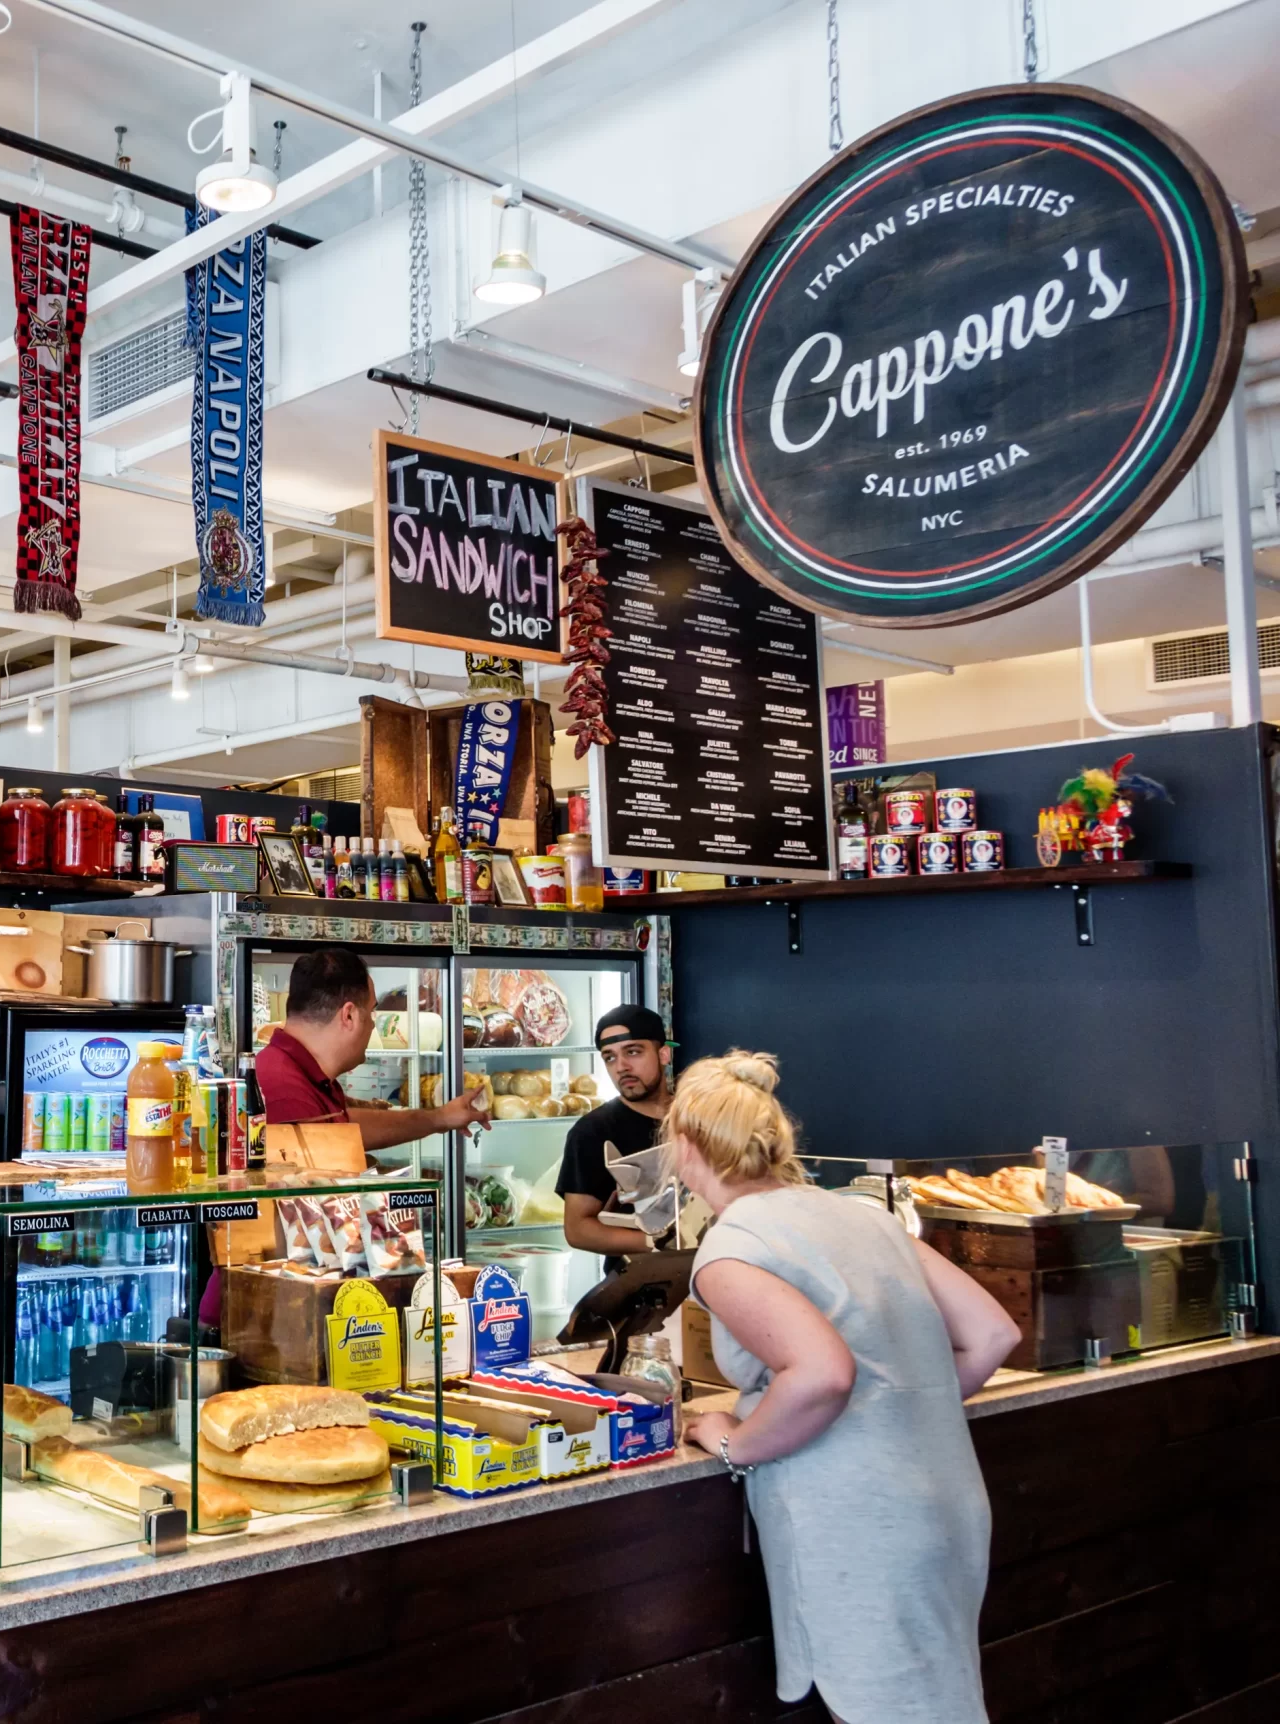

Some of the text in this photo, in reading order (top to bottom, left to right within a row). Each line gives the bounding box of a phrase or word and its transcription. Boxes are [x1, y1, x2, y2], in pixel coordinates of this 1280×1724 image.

[804, 183, 1076, 300] ITALIAN SPECIALTIES
[21, 225, 39, 298] MILAN
[71, 235, 88, 287] BEST
[769, 244, 1129, 455] Cappone's
[65, 373, 77, 407] THE
[19, 353, 38, 466] CAMPIONE
[207, 326, 245, 504] NAPOLI
[38, 364, 67, 504] MILAN
[893, 423, 989, 461] est. 1969
[65, 417, 78, 503] WINNERS
[860, 442, 1031, 499] SALUMERIA
[388, 453, 556, 543] ITALIAN
[623, 503, 651, 517] CAPPONE
[920, 509, 964, 532] NYC
[624, 538, 651, 551] ERNESTO
[391, 513, 554, 621] SANDWICH
[626, 570, 650, 582] NUNZIO
[624, 598, 655, 611] FILOMENA
[769, 604, 792, 616] PACINO
[697, 613, 728, 626] MADONNA
[629, 633, 652, 645] NAPOLI
[769, 640, 795, 651] DONATO
[700, 645, 728, 656] AVELLINO
[629, 665, 657, 677] ROBERTO
[771, 671, 797, 682] SINATRA
[700, 675, 730, 688] TRAVOLTA
[636, 698, 654, 708] ALDO
[707, 708, 727, 718] GALLO
[462, 722, 474, 741] UNA
[637, 730, 655, 740] NINA
[706, 739, 731, 749] JULIETTE
[852, 747, 878, 763] SINCE
[631, 758, 665, 770] SALVATORE
[705, 770, 736, 781] CRISTIANO
[774, 770, 807, 782] PAVAROTTI
[635, 791, 662, 802] MICHELE
[783, 805, 802, 815] SOFIA
[642, 827, 658, 836] VITO
[783, 839, 807, 849] LILIANA
[198, 861, 237, 874] Marshall
[24, 1037, 70, 1067] ITALY'S #1
[81, 1045, 130, 1062] ROCCHETTA
[26, 1047, 77, 1079] SPARKLING
[36, 1061, 72, 1085] WATER!
[390, 1194, 434, 1207] FOCACCIA
[140, 1208, 192, 1222] CIABATTA
[206, 1203, 255, 1219] TOSCANO
[13, 1216, 70, 1231] SEMOLINA
[477, 1297, 524, 1333] Linden's
[337, 1315, 387, 1350] Linden's
[490, 1321, 516, 1335] FUDGE
[494, 1331, 512, 1343] CHIP
[349, 1340, 381, 1352] BUTTER
[349, 1349, 382, 1363] CRUNCH
